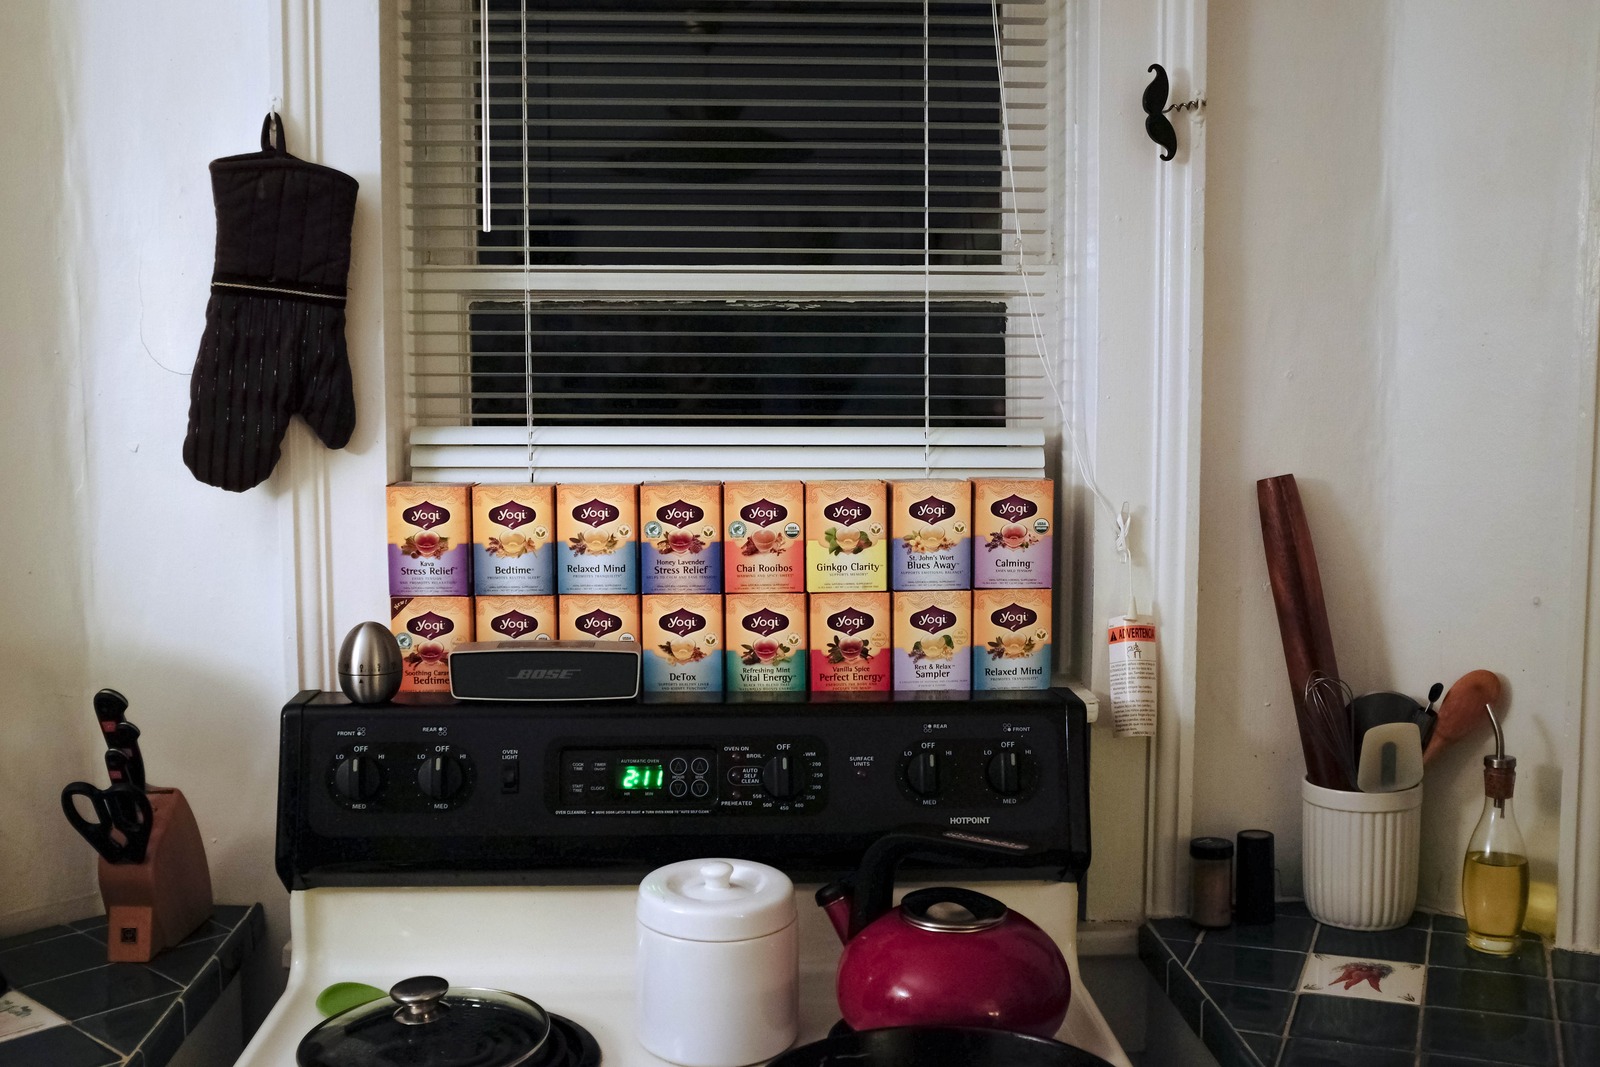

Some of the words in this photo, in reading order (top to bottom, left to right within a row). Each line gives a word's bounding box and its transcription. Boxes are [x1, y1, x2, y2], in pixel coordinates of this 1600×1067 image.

[604, 564, 626, 572] Mind
[736, 564, 755, 572] Chai
[759, 564, 793, 572] Rooibos
[817, 563, 848, 573] Ginkgo
[851, 563, 879, 572] Clarity
[933, 561, 956, 570] Away
[995, 559, 1031, 569] Calming
[401, 567, 426, 575] Stress
[495, 566, 531, 574] Bedtime
[654, 566, 680, 574] Stress
[683, 566, 708, 574] Relief
[507, 669, 581, 680] BOSE
[916, 670, 950, 679] Sampler
[985, 668, 1018, 676] Relaxed
[1021, 667, 1042, 675] Mind
[764, 674, 792, 683] Energy
[852, 673, 882, 682] Energy
[624, 769, 663, 787] 2:11
